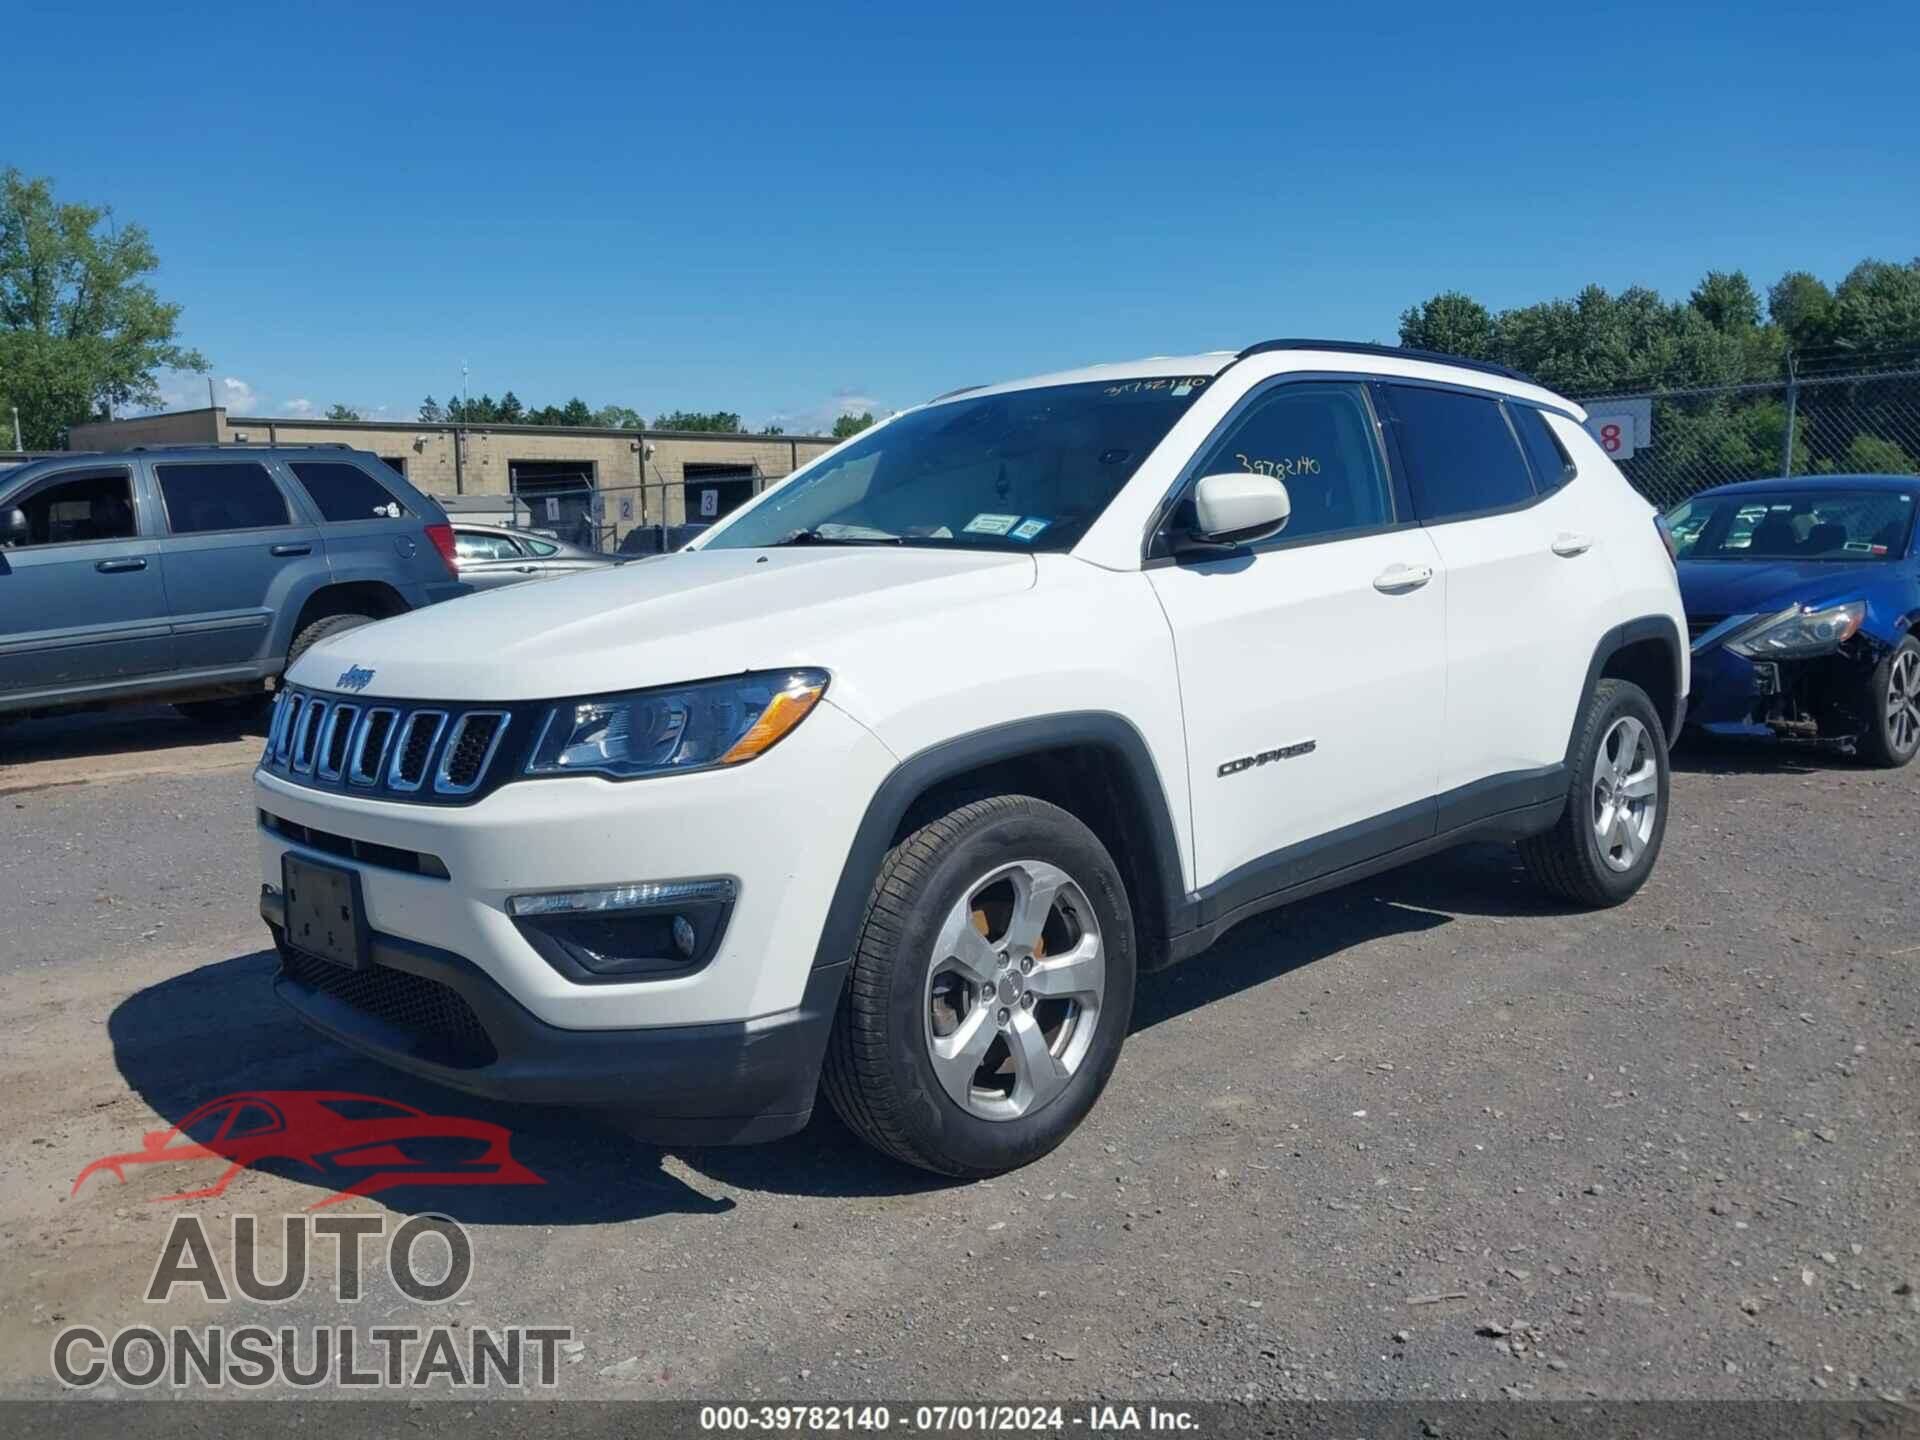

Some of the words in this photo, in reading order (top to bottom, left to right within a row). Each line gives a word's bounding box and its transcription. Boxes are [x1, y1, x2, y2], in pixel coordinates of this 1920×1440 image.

[1600, 424, 1621, 453] 8
[1235, 453, 1321, 481] 39782140
[622, 501, 631, 518] 2
[704, 495, 713, 512] 3
[1217, 739, 1317, 778] COMPASS
